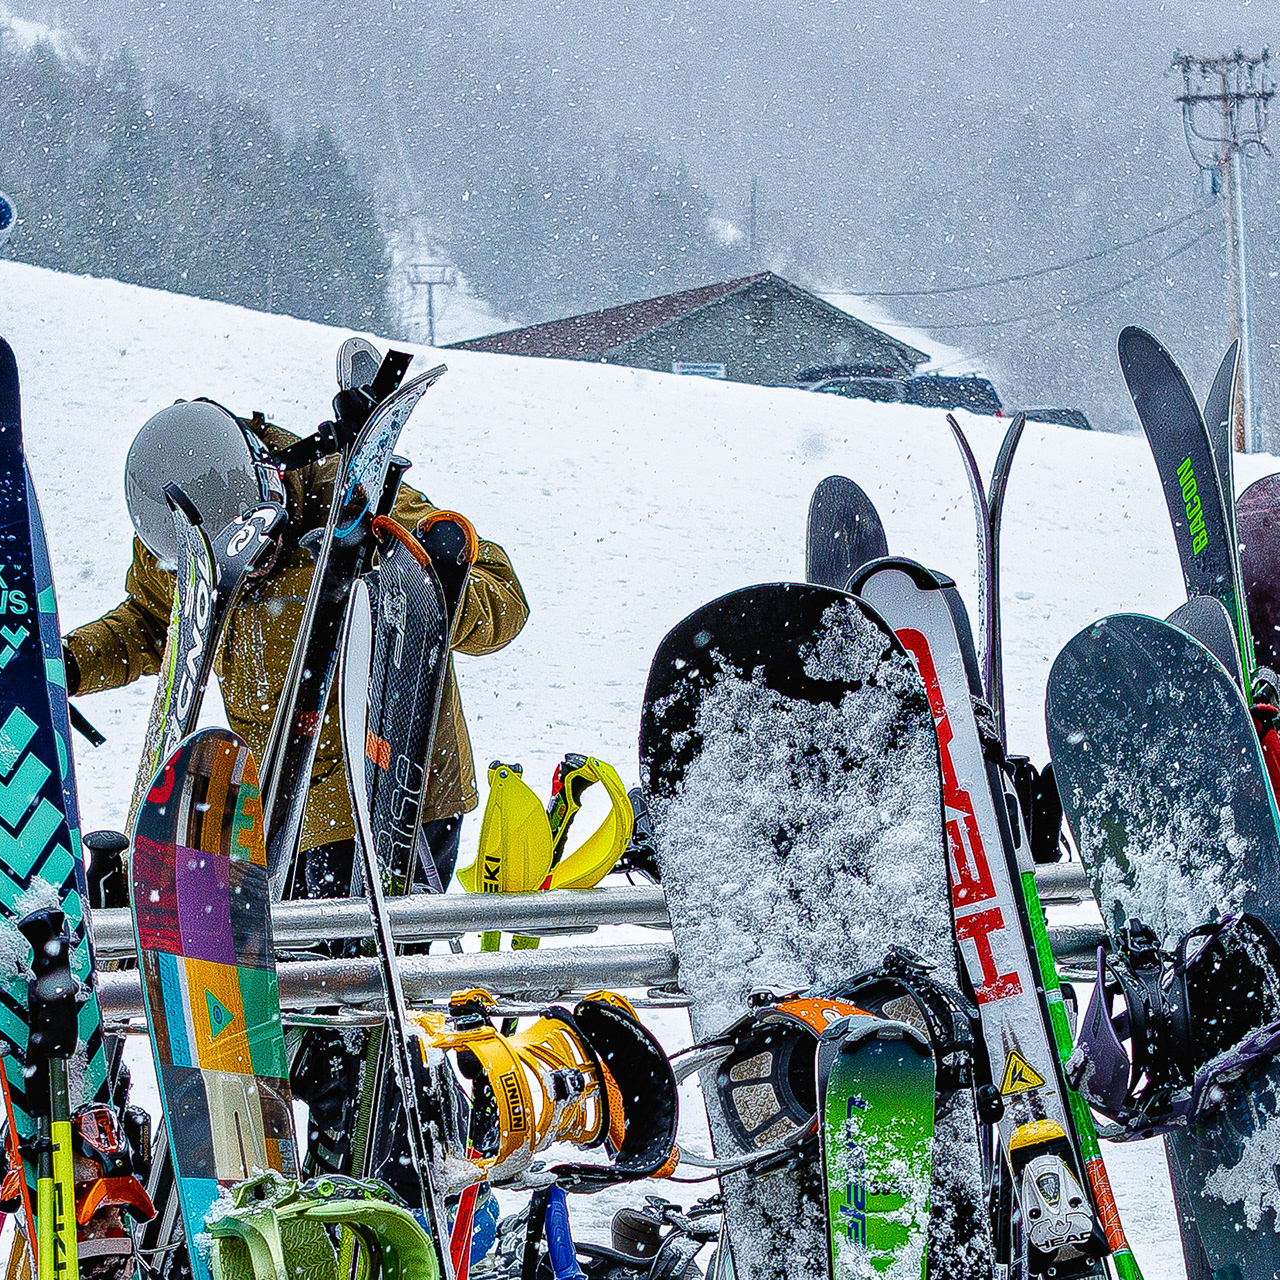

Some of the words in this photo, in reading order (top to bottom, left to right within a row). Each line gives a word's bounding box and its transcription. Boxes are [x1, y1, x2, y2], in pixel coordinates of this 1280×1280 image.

[1177, 457, 1209, 555] BACON
[483, 855, 501, 892] EKI
[504, 1076, 523, 1129] UNION
